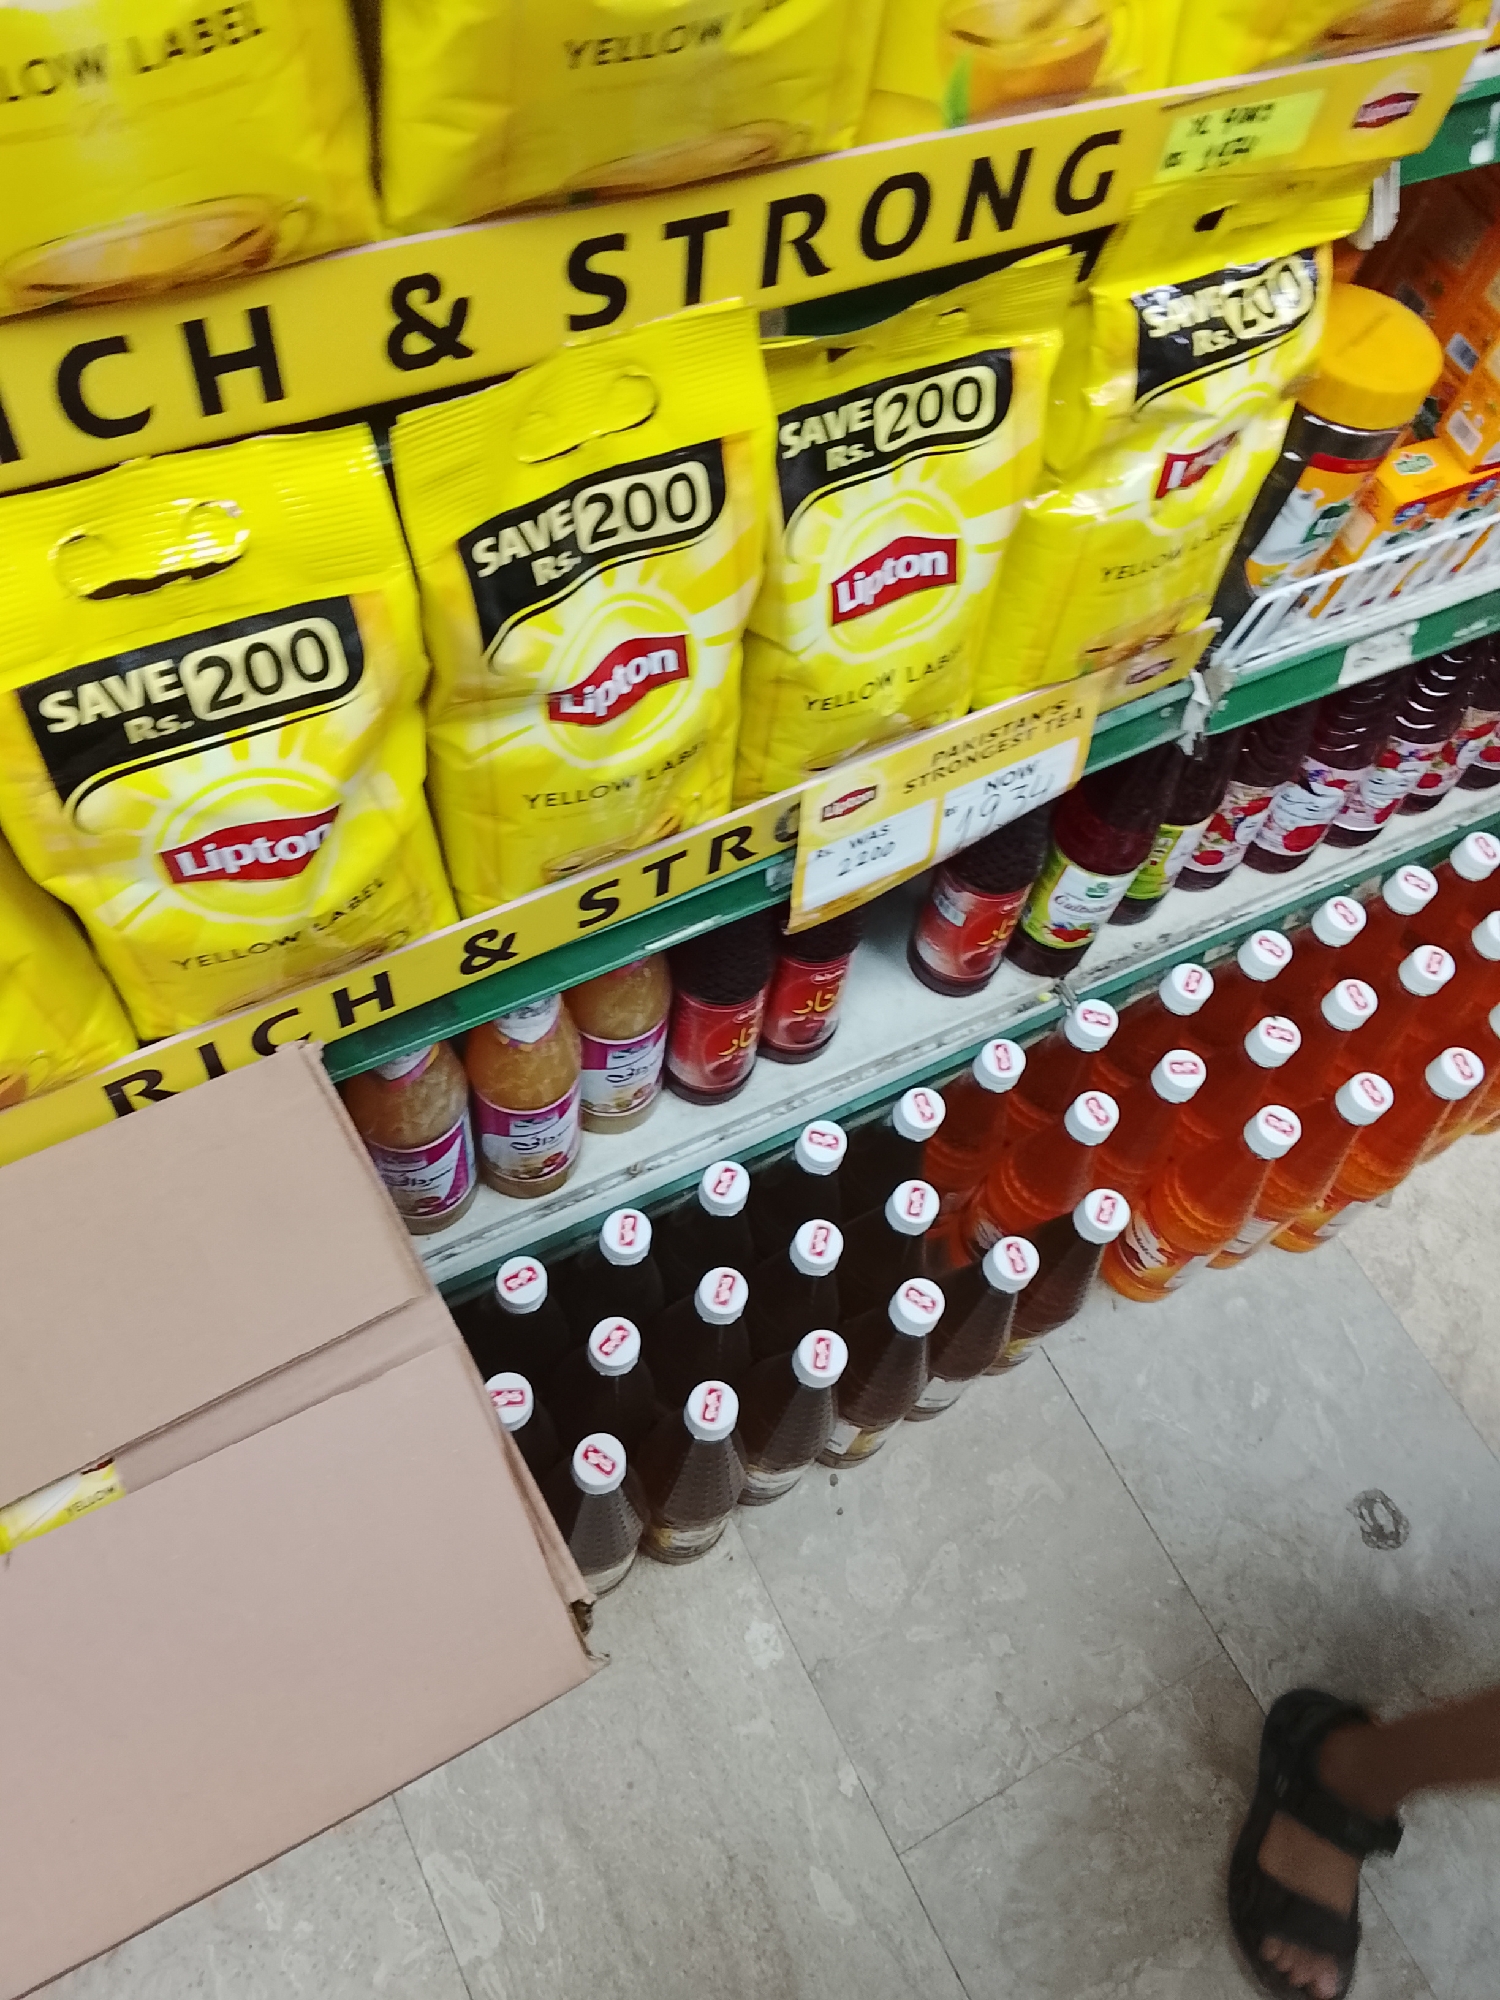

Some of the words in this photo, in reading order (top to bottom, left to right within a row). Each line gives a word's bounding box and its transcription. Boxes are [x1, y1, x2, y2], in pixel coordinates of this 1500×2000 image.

[124, 1, 268, 76] LABEL
[562, 13, 733, 70] YELLOW
[386, 272, 476, 371] &
[567, 128, 1124, 332] STRONG
[778, 397, 875, 460] SAVE
[885, 375, 982, 446] 200
[826, 444, 875, 471] Rs.
[472, 499, 576, 578] SAVE
[583, 472, 697, 545] 200
[531, 551, 582, 587] Rs.
[836, 550, 949, 614] Lipton
[38, 658, 186, 733] SAVE
[196, 628, 330, 714] 200
[558, 648, 681, 717] Lipton
[803, 666, 897, 711] YELLOW
[123, 714, 195, 745] Rs.
[902, 728, 1037, 795] STRONGEST
[1044, 705, 1086, 733] TEA
[930, 699, 1069, 768] PAKISTAN'S
[522, 774, 638, 810] YELLOW
[981, 758, 1043, 795] NOW
[849, 823, 891, 849] WAS
[170, 930, 301, 971] YELLOW
[312, 877, 385, 932] LABEL
[459, 928, 519, 976] &
